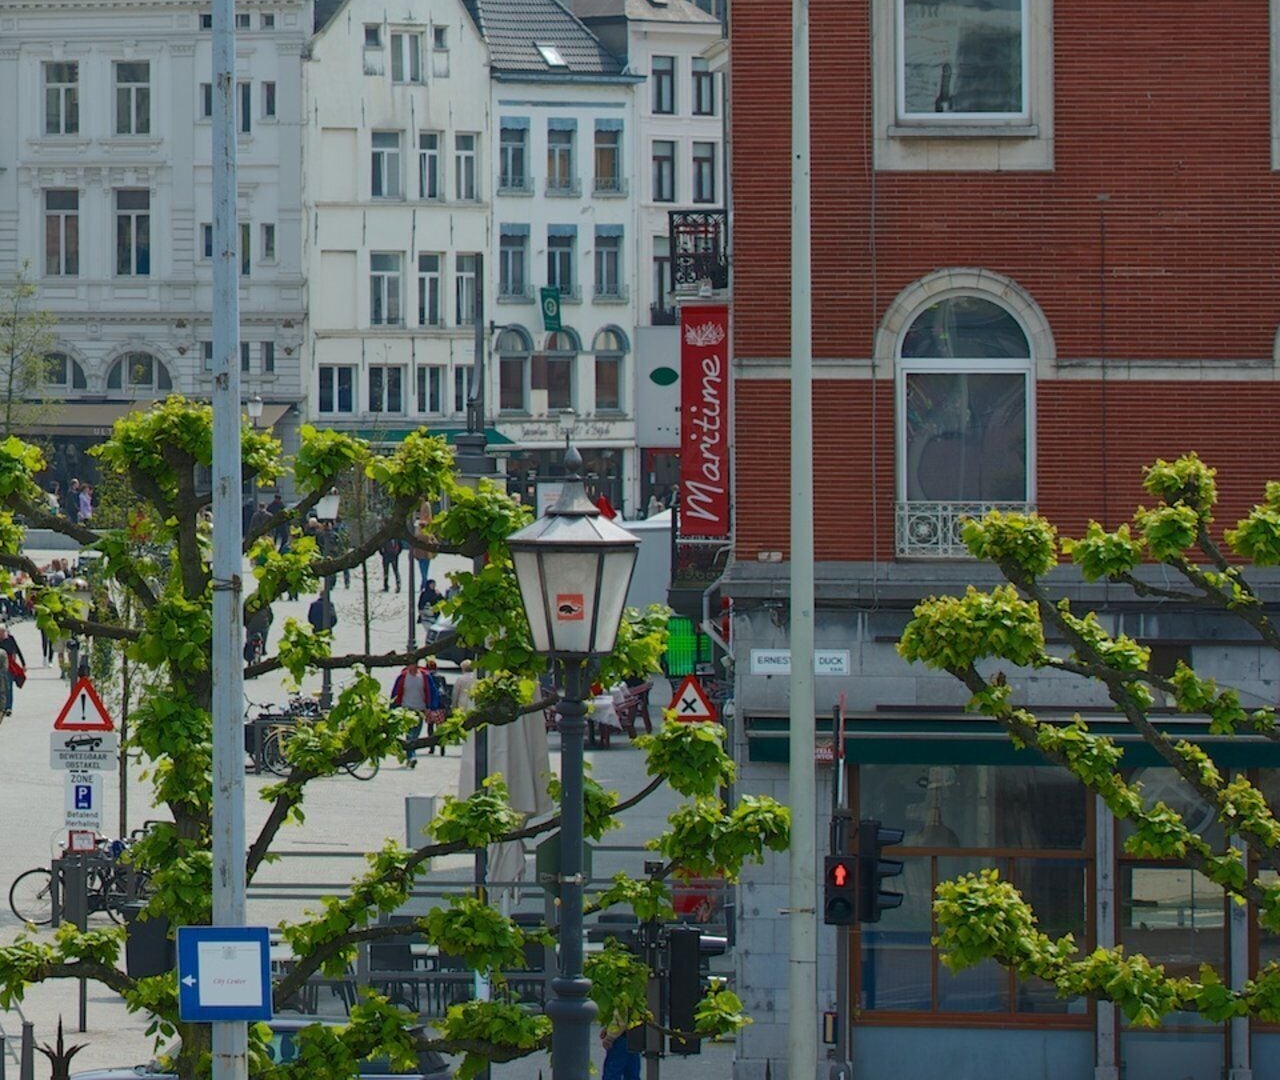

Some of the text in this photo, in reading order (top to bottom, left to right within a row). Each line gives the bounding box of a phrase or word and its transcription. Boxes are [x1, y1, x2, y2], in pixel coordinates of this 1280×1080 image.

[685, 354, 724, 522] Maritime
[71, 774, 94, 783] ZONE
[78, 787, 88, 800] P
[65, 820, 100, 829] Herhaling
[212, 978, 225, 986] City
